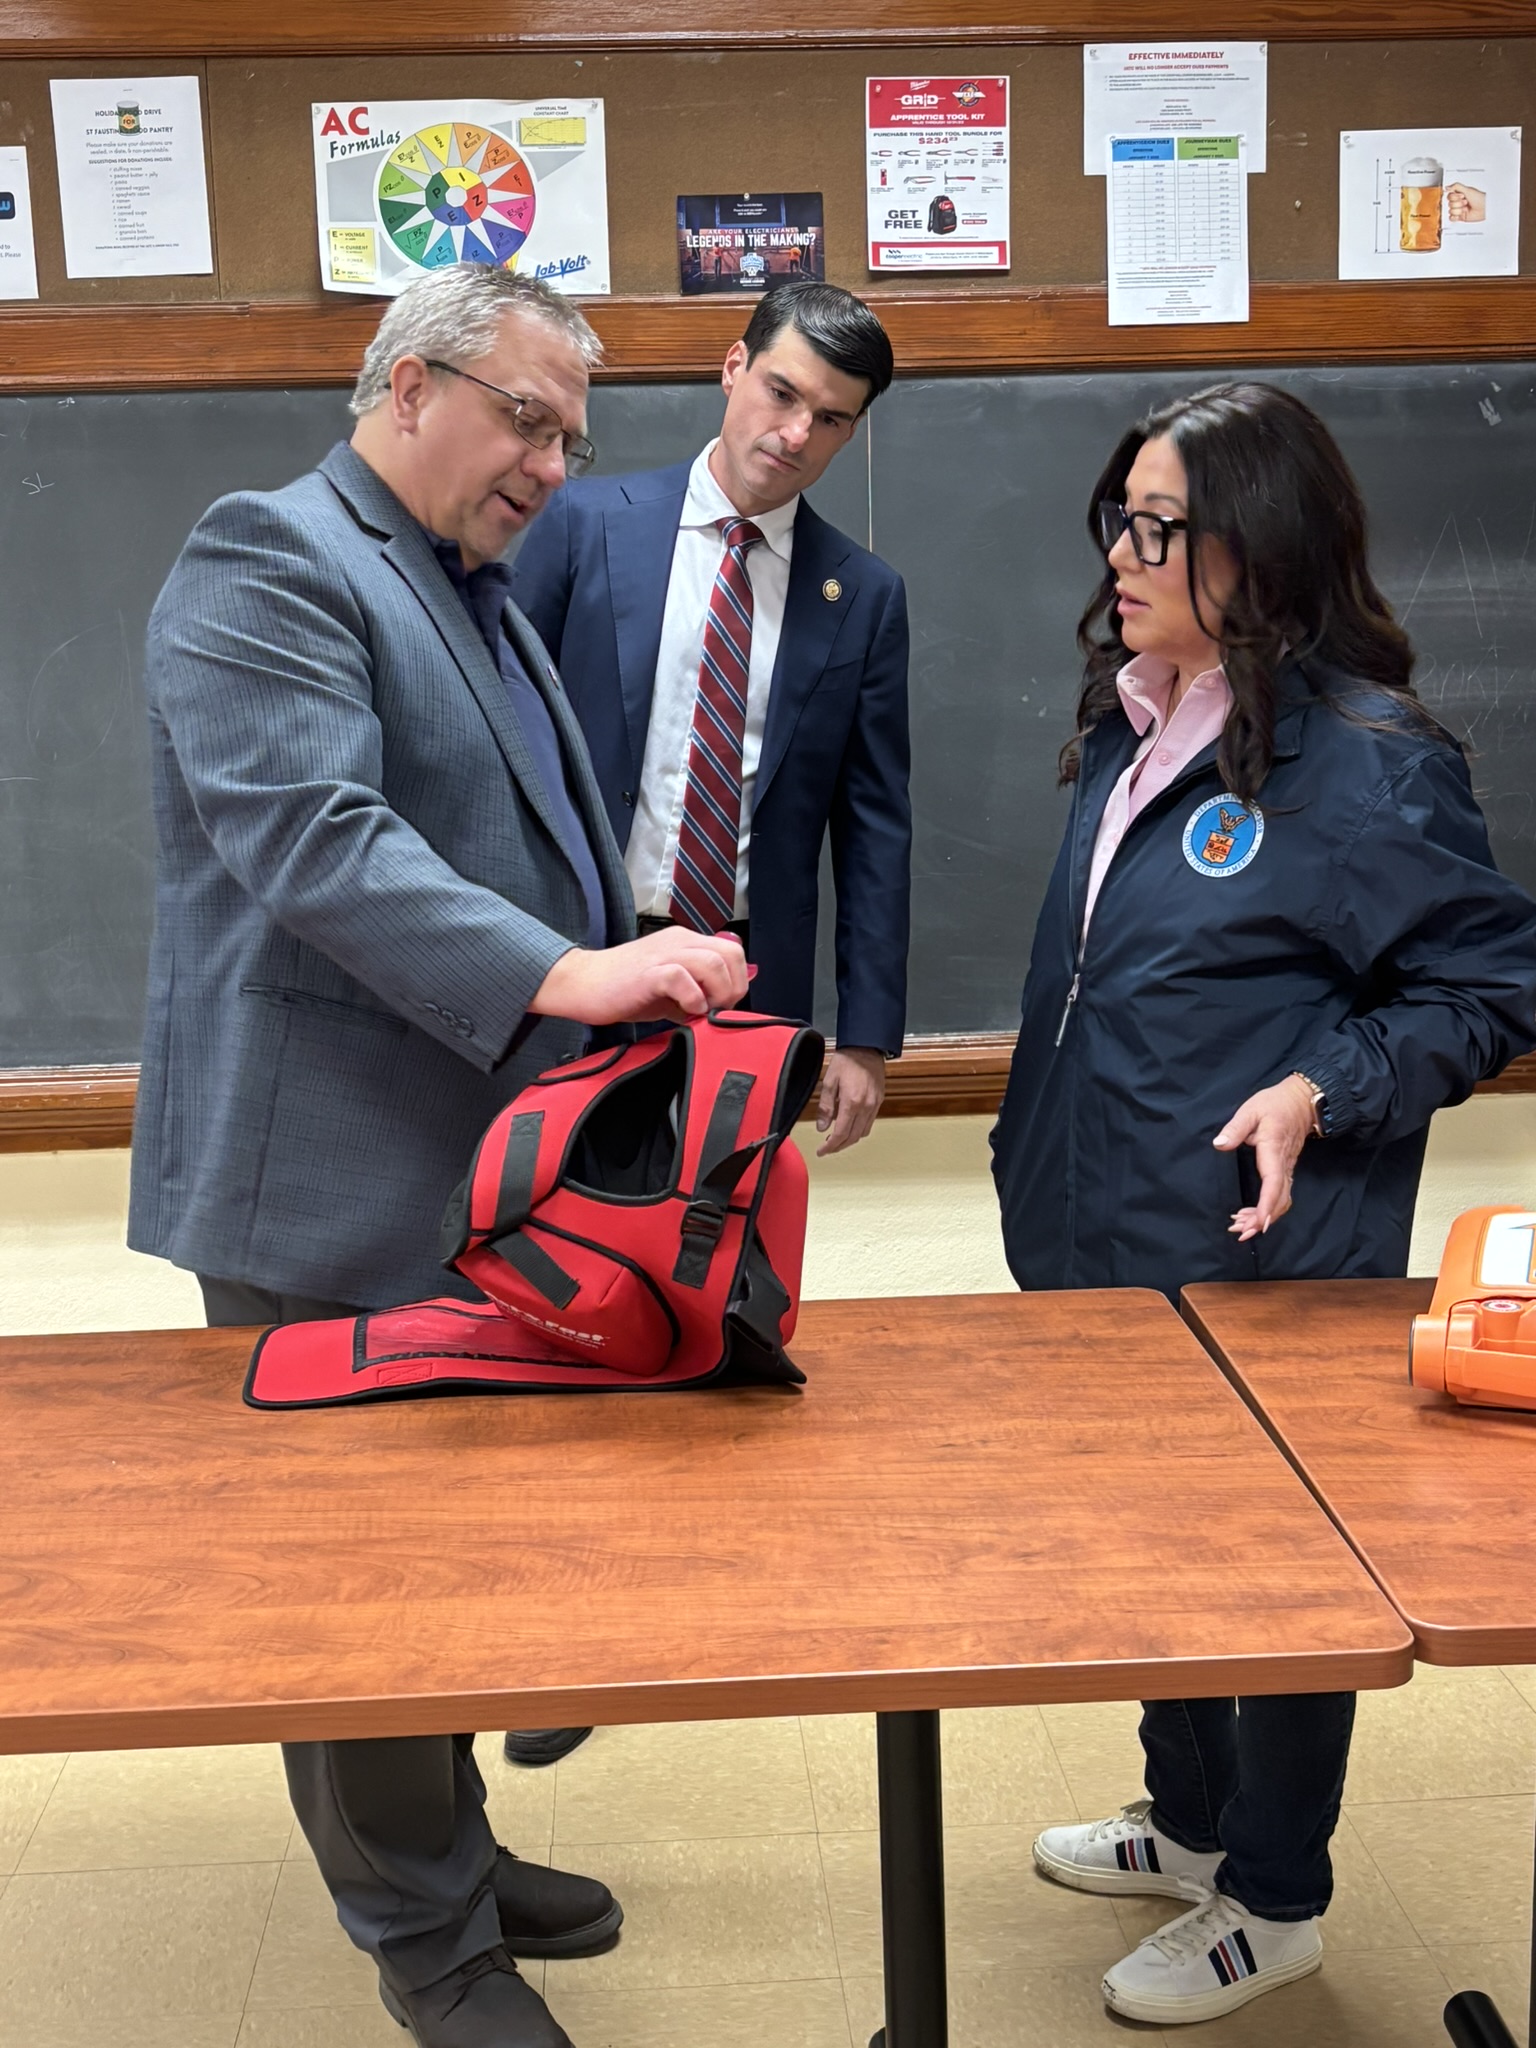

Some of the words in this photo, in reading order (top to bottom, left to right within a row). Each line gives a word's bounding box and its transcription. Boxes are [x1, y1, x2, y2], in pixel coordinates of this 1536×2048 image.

[1128, 52, 1171, 61] EFFECTIVE
[1171, 51, 1225, 60] IMMEDIATELY
[320, 106, 370, 136] AC
[330, 130, 401, 159] Formulas
[458, 172, 466, 182] I
[432, 187, 442, 199] P
[472, 194, 483, 207] Z
[447, 210, 457, 222] E
[888, 210, 918, 219] GET
[884, 220, 922, 229] FREE
[686, 235, 732, 248] LEGENDS
[735, 234, 745, 247] IN
[748, 234, 767, 247] THE
[770, 233, 816, 246] MAKING?
[1183, 830, 1194, 858] UNITED
[1190, 857, 1212, 875] STATES
[1226, 848, 1256, 874] AMERICA
